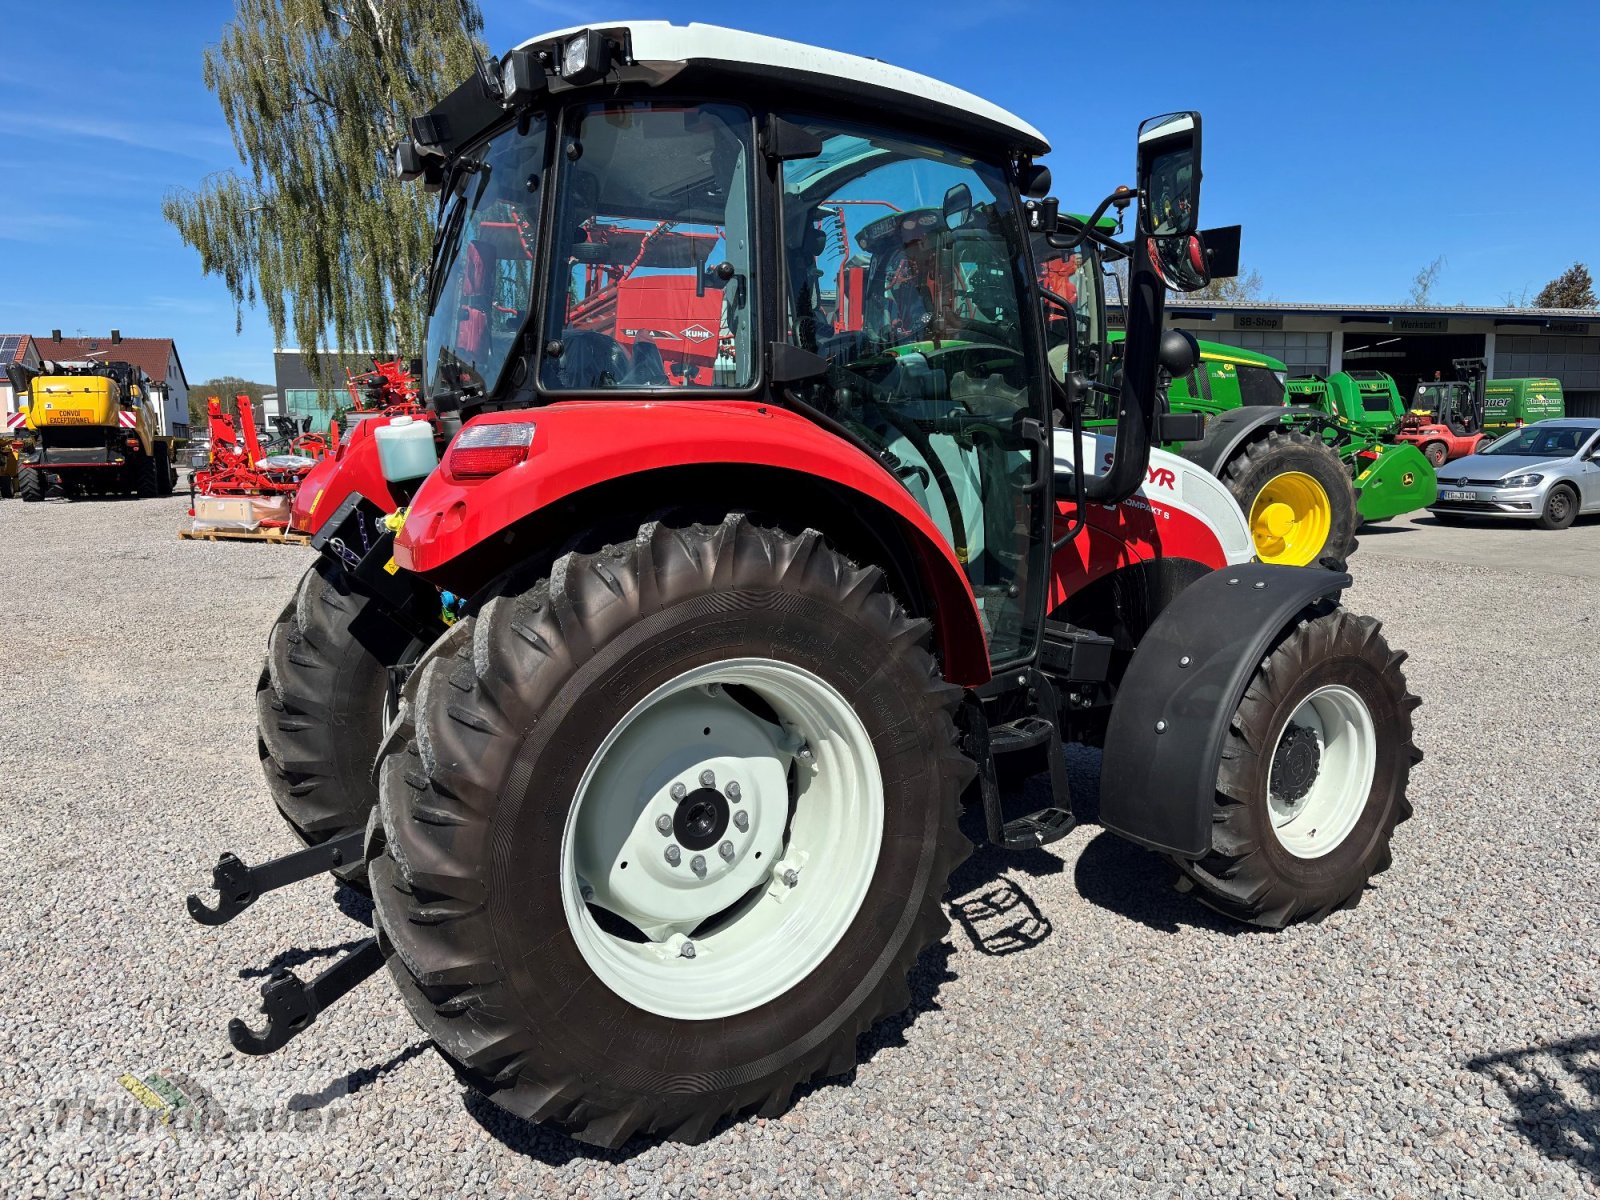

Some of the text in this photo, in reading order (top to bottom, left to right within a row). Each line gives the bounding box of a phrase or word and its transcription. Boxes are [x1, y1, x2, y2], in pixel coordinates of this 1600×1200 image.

[1239, 314, 1277, 328] SB-Shop
[1400, 319, 1436, 329] Werkstatt
[685, 330, 709, 338] KUHN
[1101, 452, 1175, 490] SYR
[1123, 498, 1162, 515] OMPAKT
